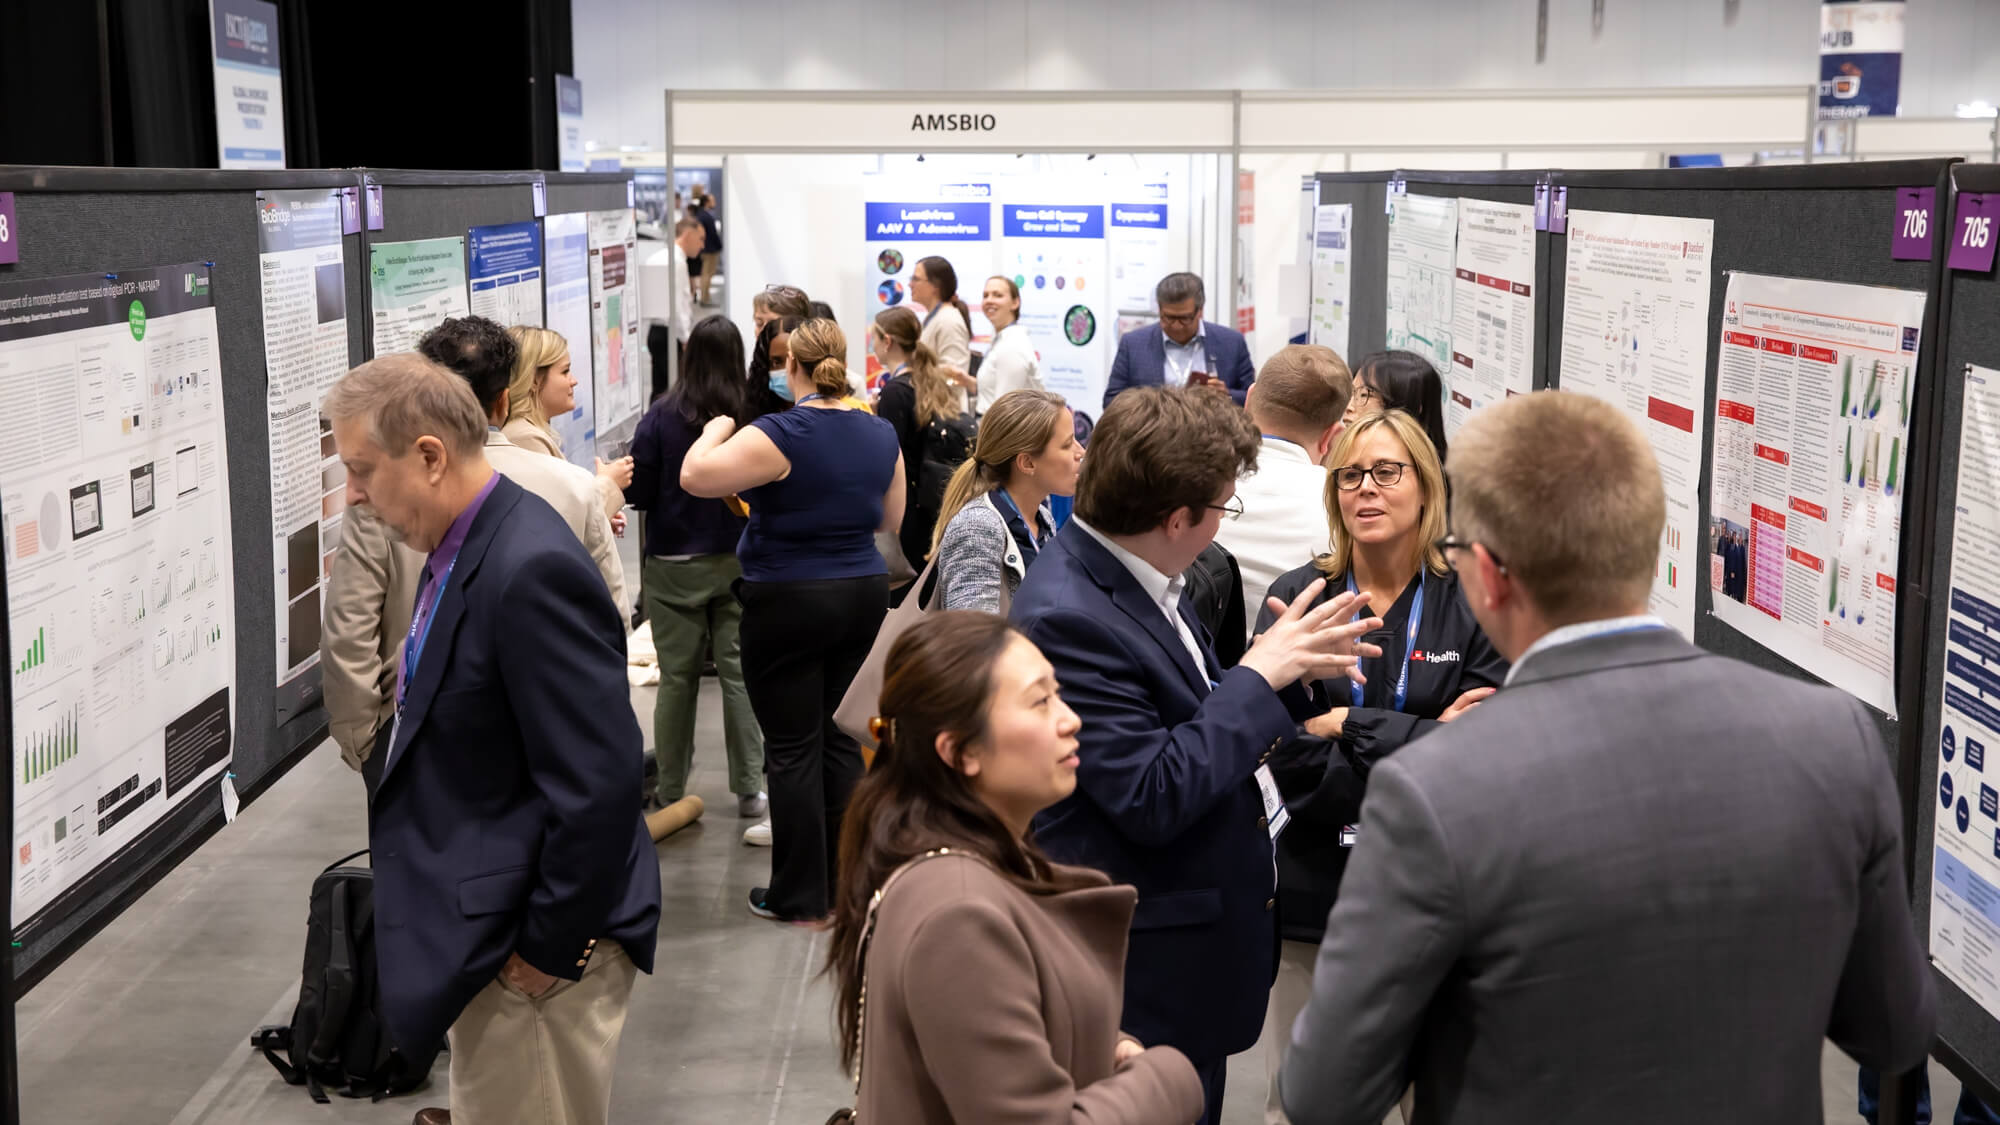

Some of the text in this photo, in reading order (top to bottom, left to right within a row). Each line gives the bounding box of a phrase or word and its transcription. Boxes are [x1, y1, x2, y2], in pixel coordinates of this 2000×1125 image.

[911, 114, 996, 131] AMSBIO
[261, 208, 291, 226] BioBridge
[1903, 209, 1928, 238] 706
[876, 222, 904, 234] AAV
[1962, 217, 1991, 248] 705
[124, 281, 136, 295] PCR
[1426, 650, 1460, 663] Health
